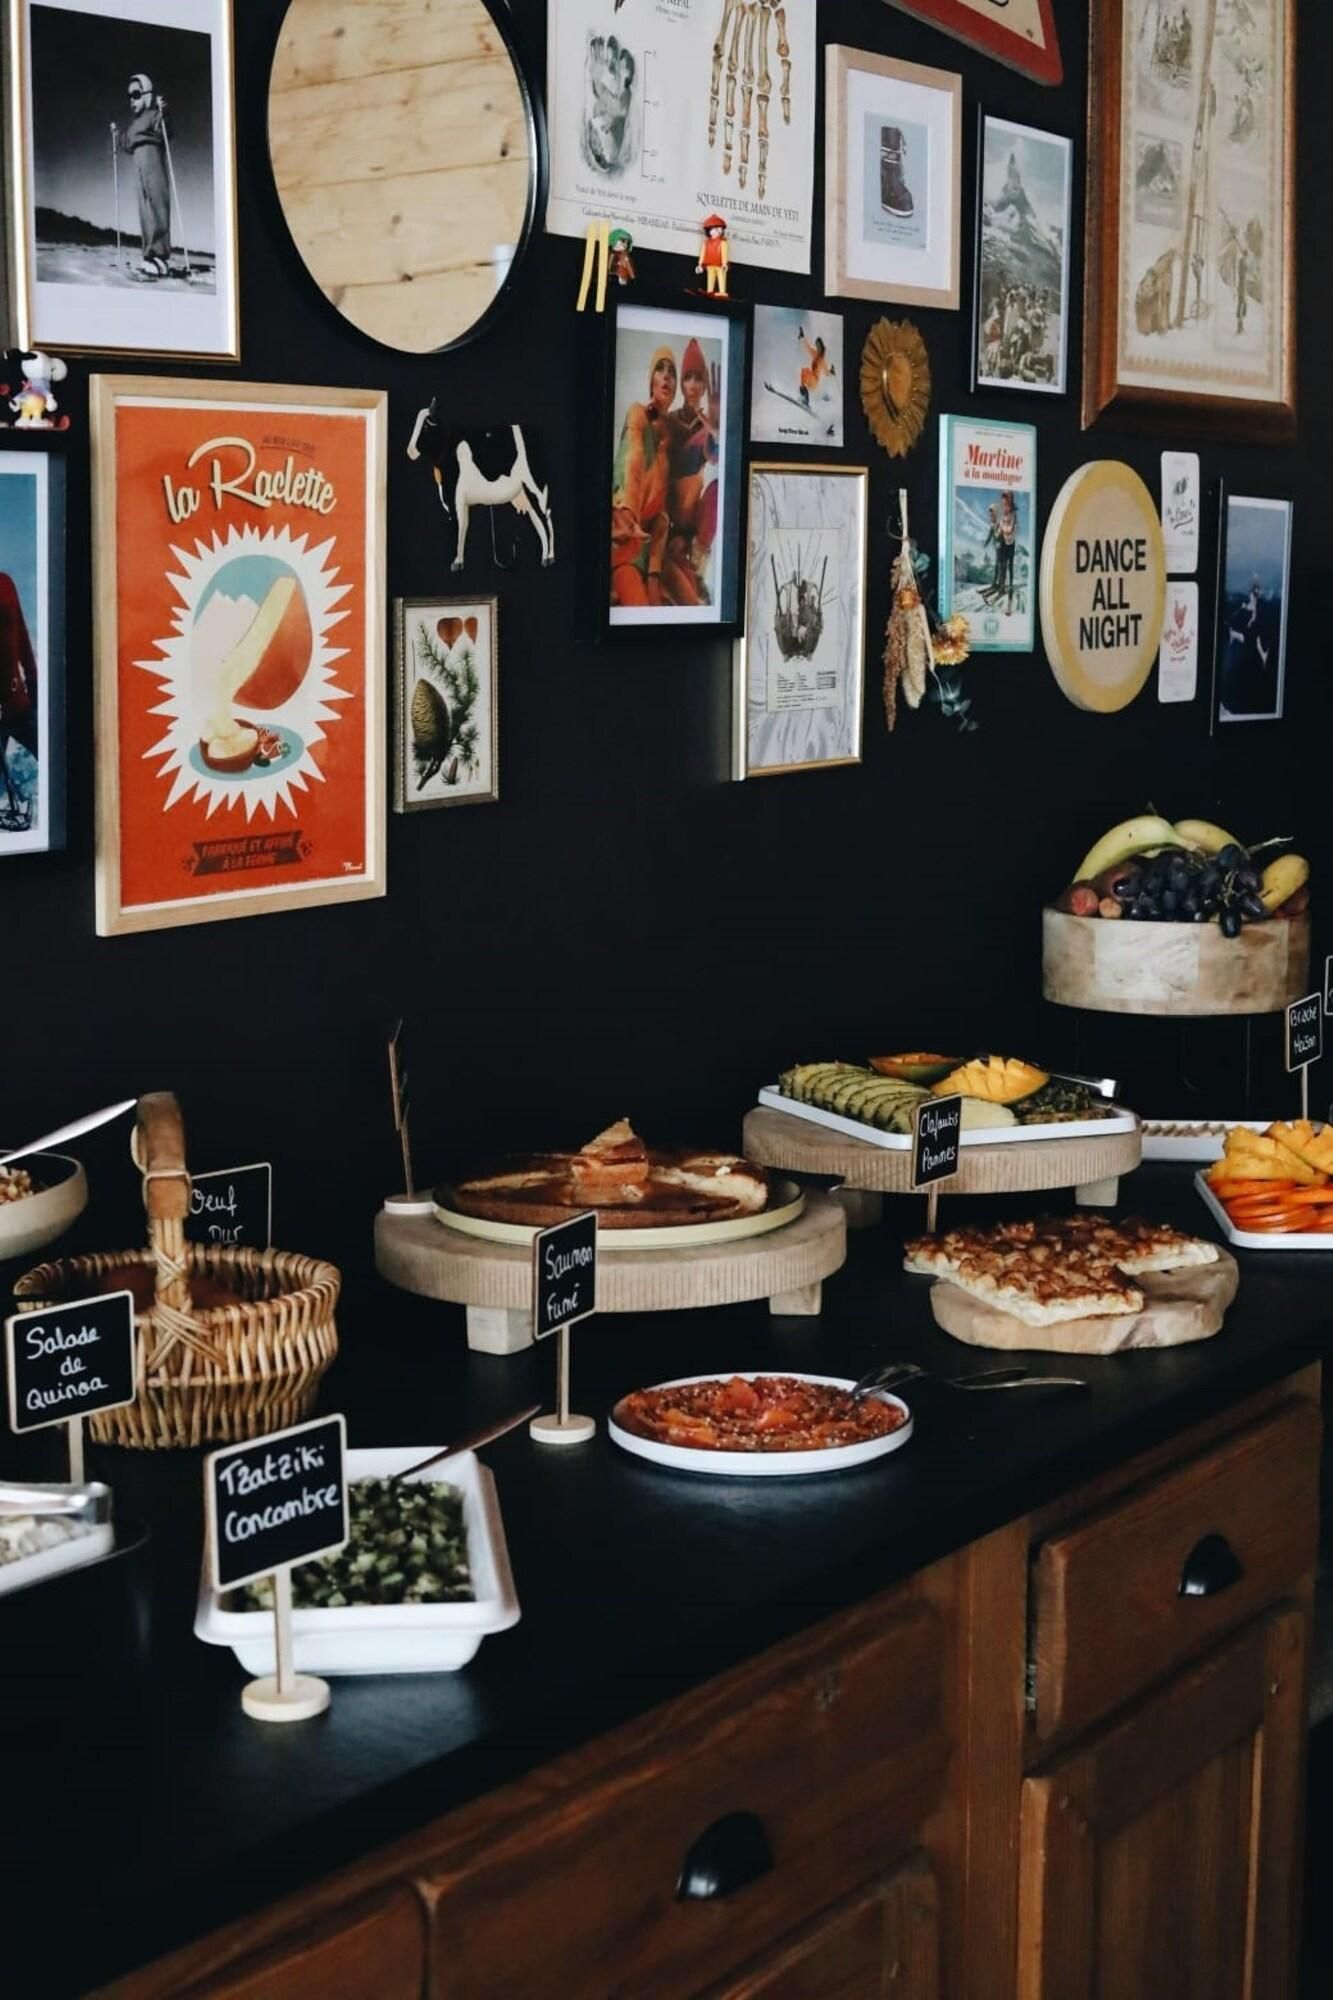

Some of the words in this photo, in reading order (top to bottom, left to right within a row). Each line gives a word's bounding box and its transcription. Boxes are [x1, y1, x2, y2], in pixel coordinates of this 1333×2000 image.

[750, 202, 771, 216] MAIN
[965, 443, 1023, 469] Martine
[163, 474, 200, 523] la
[187, 436, 337, 515] Raclette
[1076, 538, 1146, 573] DANCE
[1092, 577, 1130, 611] ALL
[1080, 613, 1142, 651] NIGHT
[545, 1243, 592, 1280] Saumon
[26, 1326, 101, 1359] Salade
[60, 1356, 87, 1376] de
[26, 1377, 109, 1410] Quinoa
[219, 1444, 325, 1496] Tzatziki
[224, 1483, 341, 1543] Concombre
